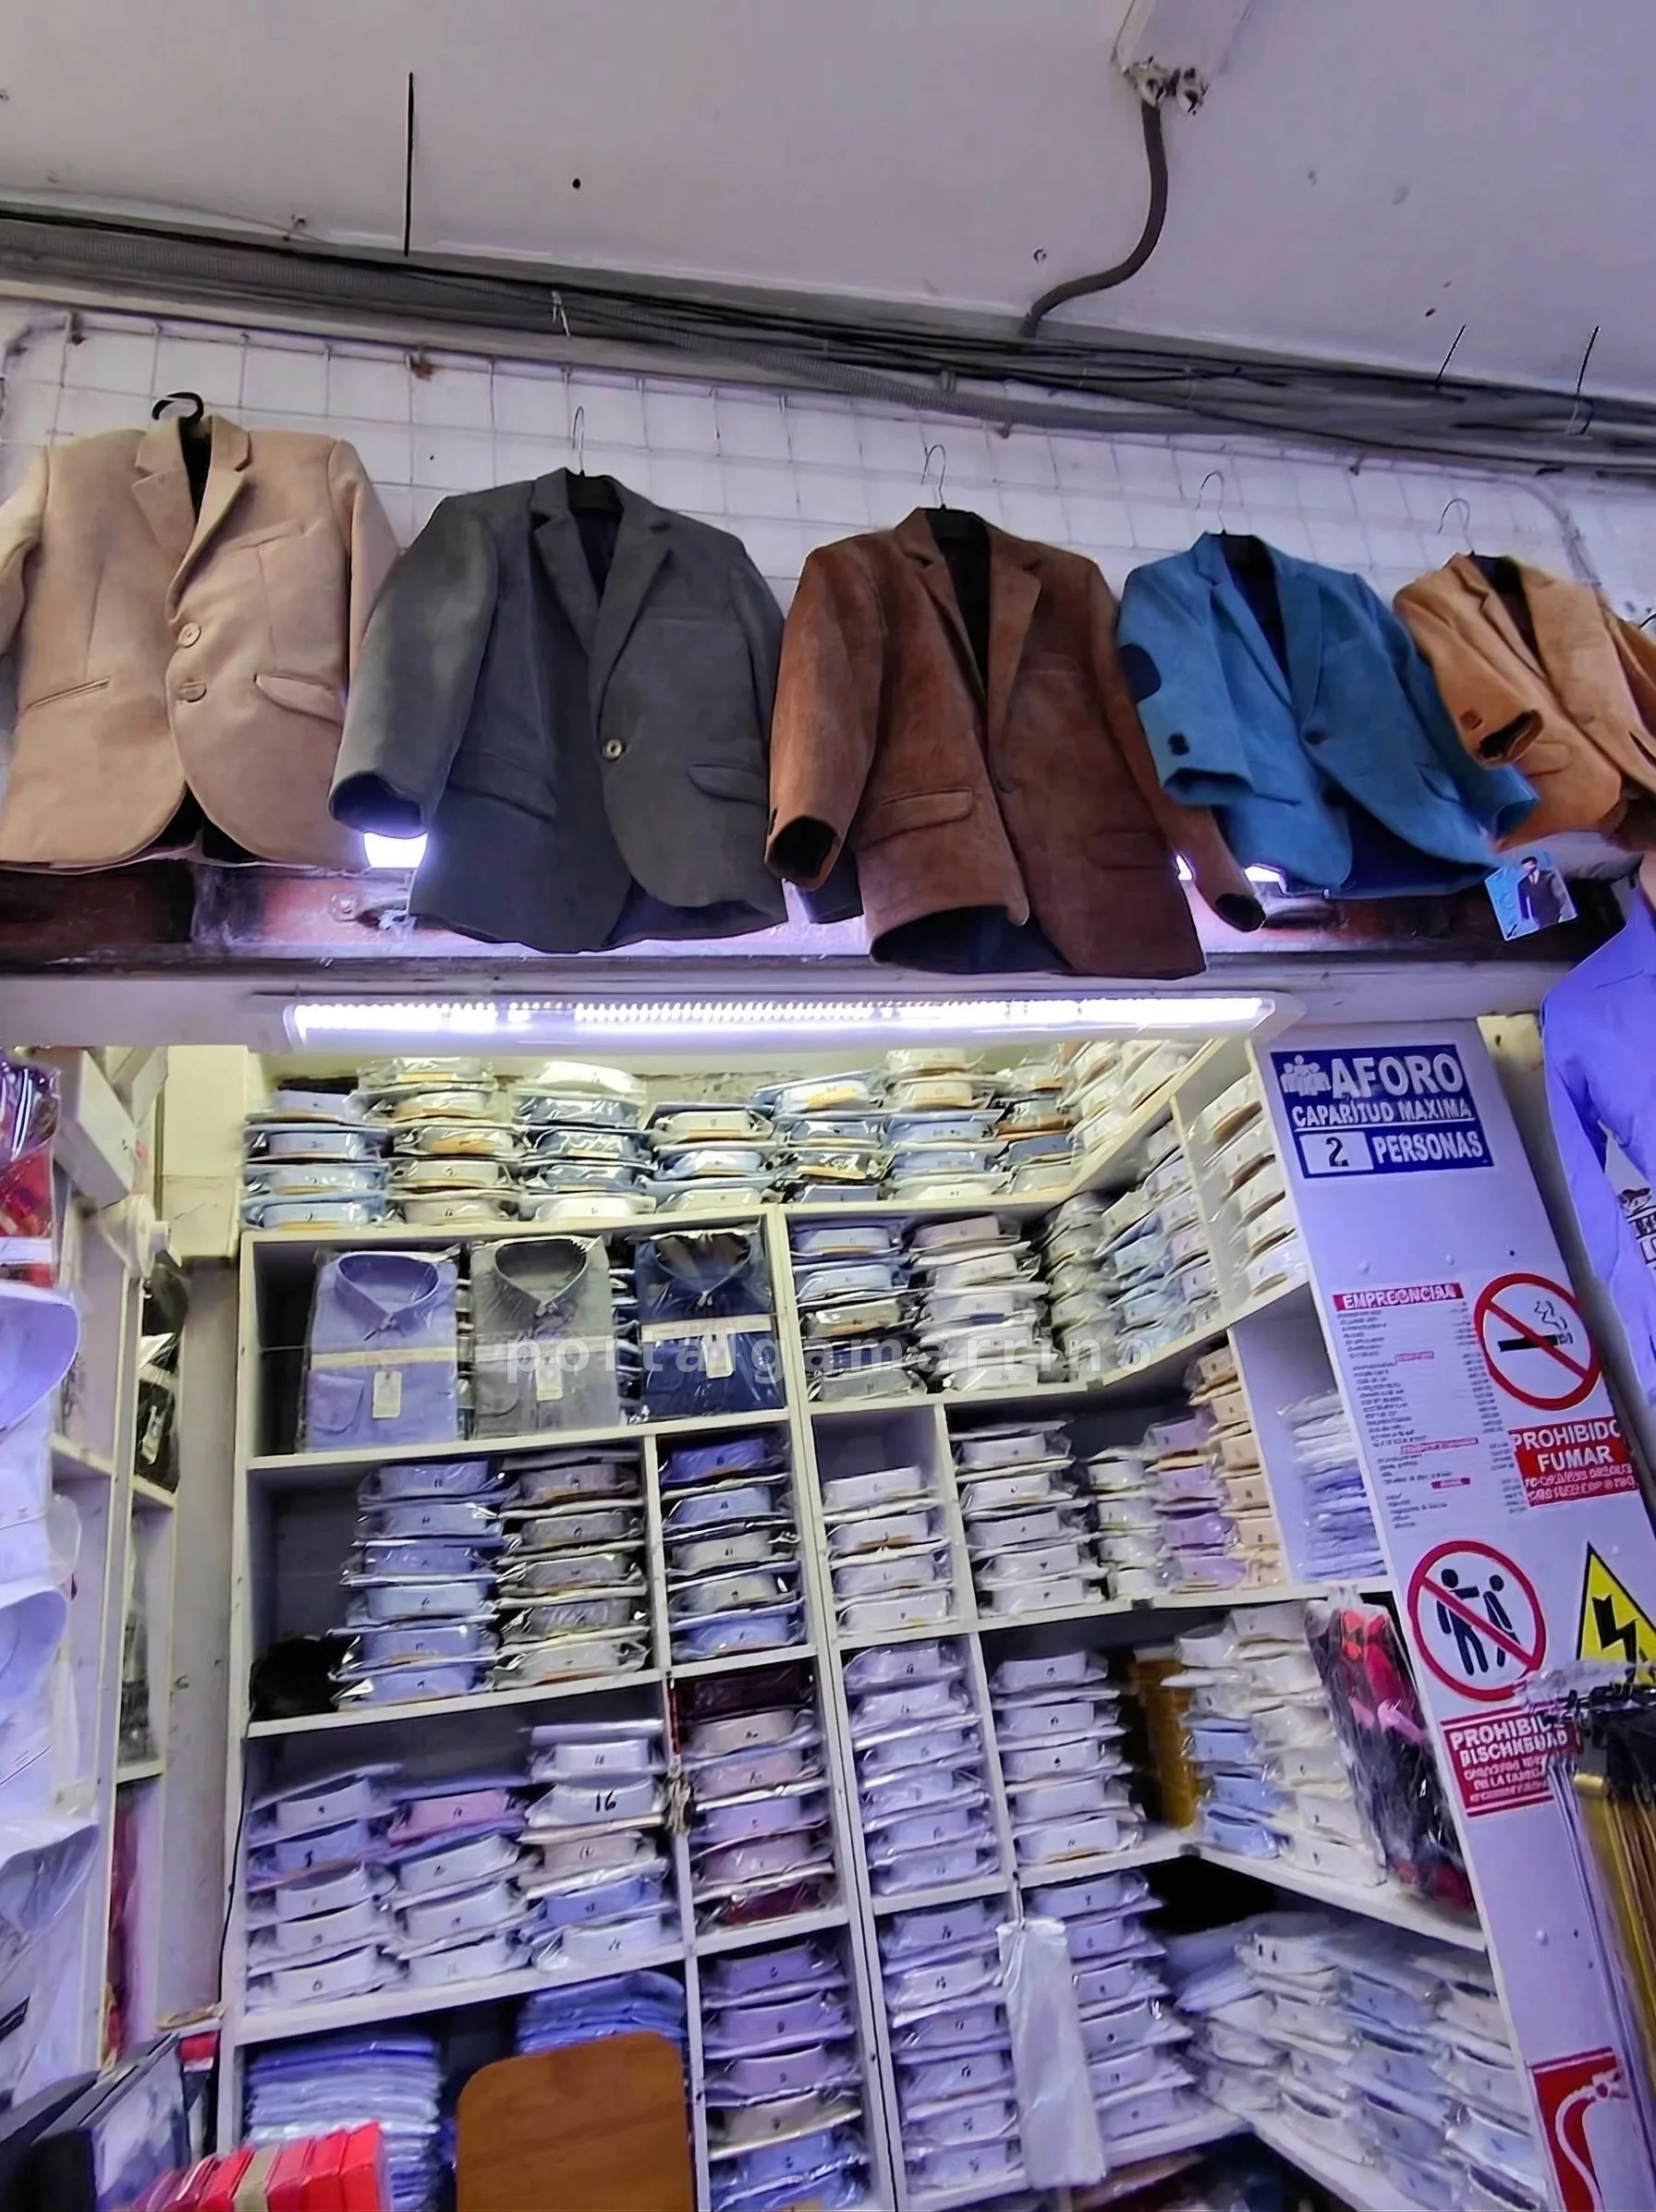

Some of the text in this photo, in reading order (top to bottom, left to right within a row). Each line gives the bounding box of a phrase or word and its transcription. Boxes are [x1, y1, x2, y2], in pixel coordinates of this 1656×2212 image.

[1331, 1053, 1464, 1100] AFORO
[1325, 1130, 1484, 1167] 2 PERSONAS
[1537, 1445, 1614, 1473] FUMAR
[1449, 1715, 1565, 1751] PROHIBI
[595, 1789, 617, 1813] 16
